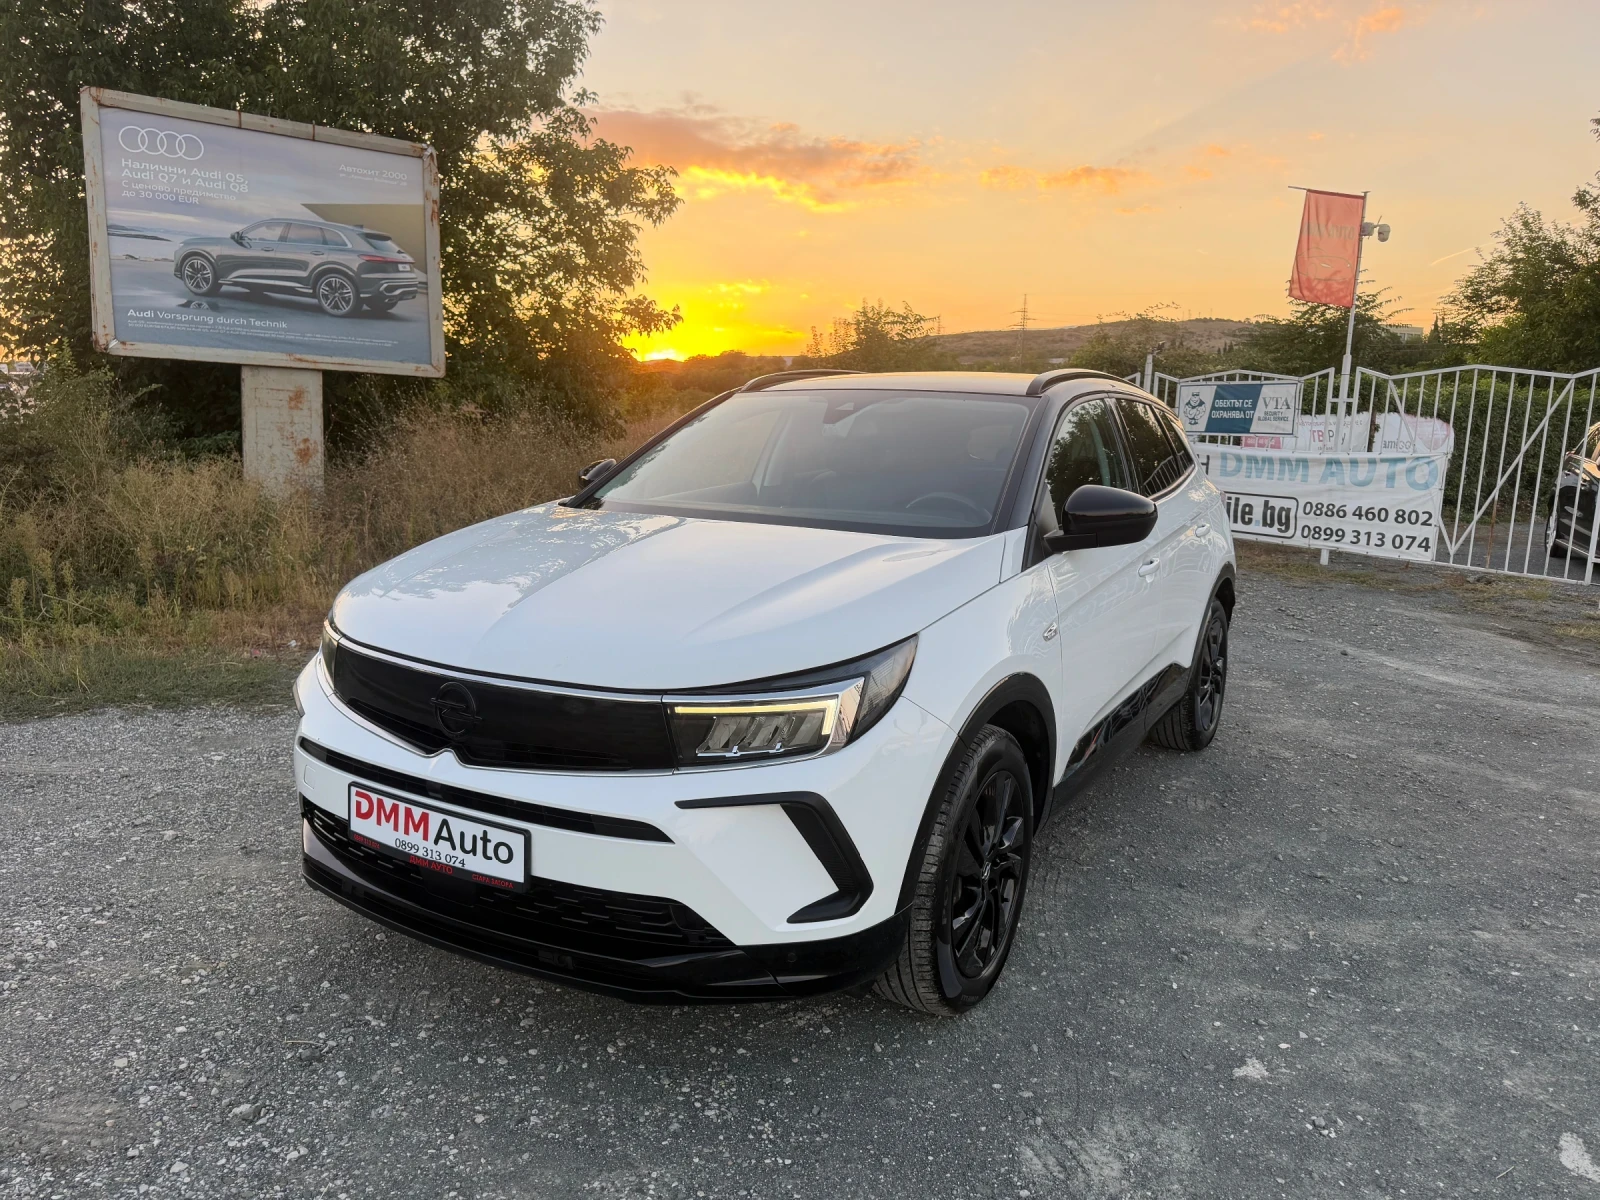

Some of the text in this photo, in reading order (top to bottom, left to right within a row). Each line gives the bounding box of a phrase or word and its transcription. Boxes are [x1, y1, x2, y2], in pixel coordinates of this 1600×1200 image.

[121, 158, 249, 185] Налични Audi Q5,
[121, 168, 249, 193] Audi Q7 и Audi Q8
[339, 164, 380, 177] Автохит
[382, 170, 408, 180] 2000
[121, 190, 200, 205] до 30 000 EUR
[131, 182, 171, 192] ценово
[173, 187, 237, 201] предимство
[127, 308, 288, 329] Audi Vorsprung durch Technik
[1214, 399, 1253, 408] ОБЕКТЪТ СЕ
[1262, 396, 1291, 410] VTA
[1211, 410, 1255, 419] ОХРАНЯВА ОТ
[1220, 452, 1310, 483] DMM
[1318, 456, 1439, 491] AUTO
[1226, 496, 1292, 533] ile.bg
[1302, 501, 1433, 526] 0886 460 802
[1300, 524, 1431, 552] 0899 313 074
[394, 838, 466, 868] 0899 313 074
[431, 861, 453, 875] АУТО
[471, 873, 490, 884] СТАРА
